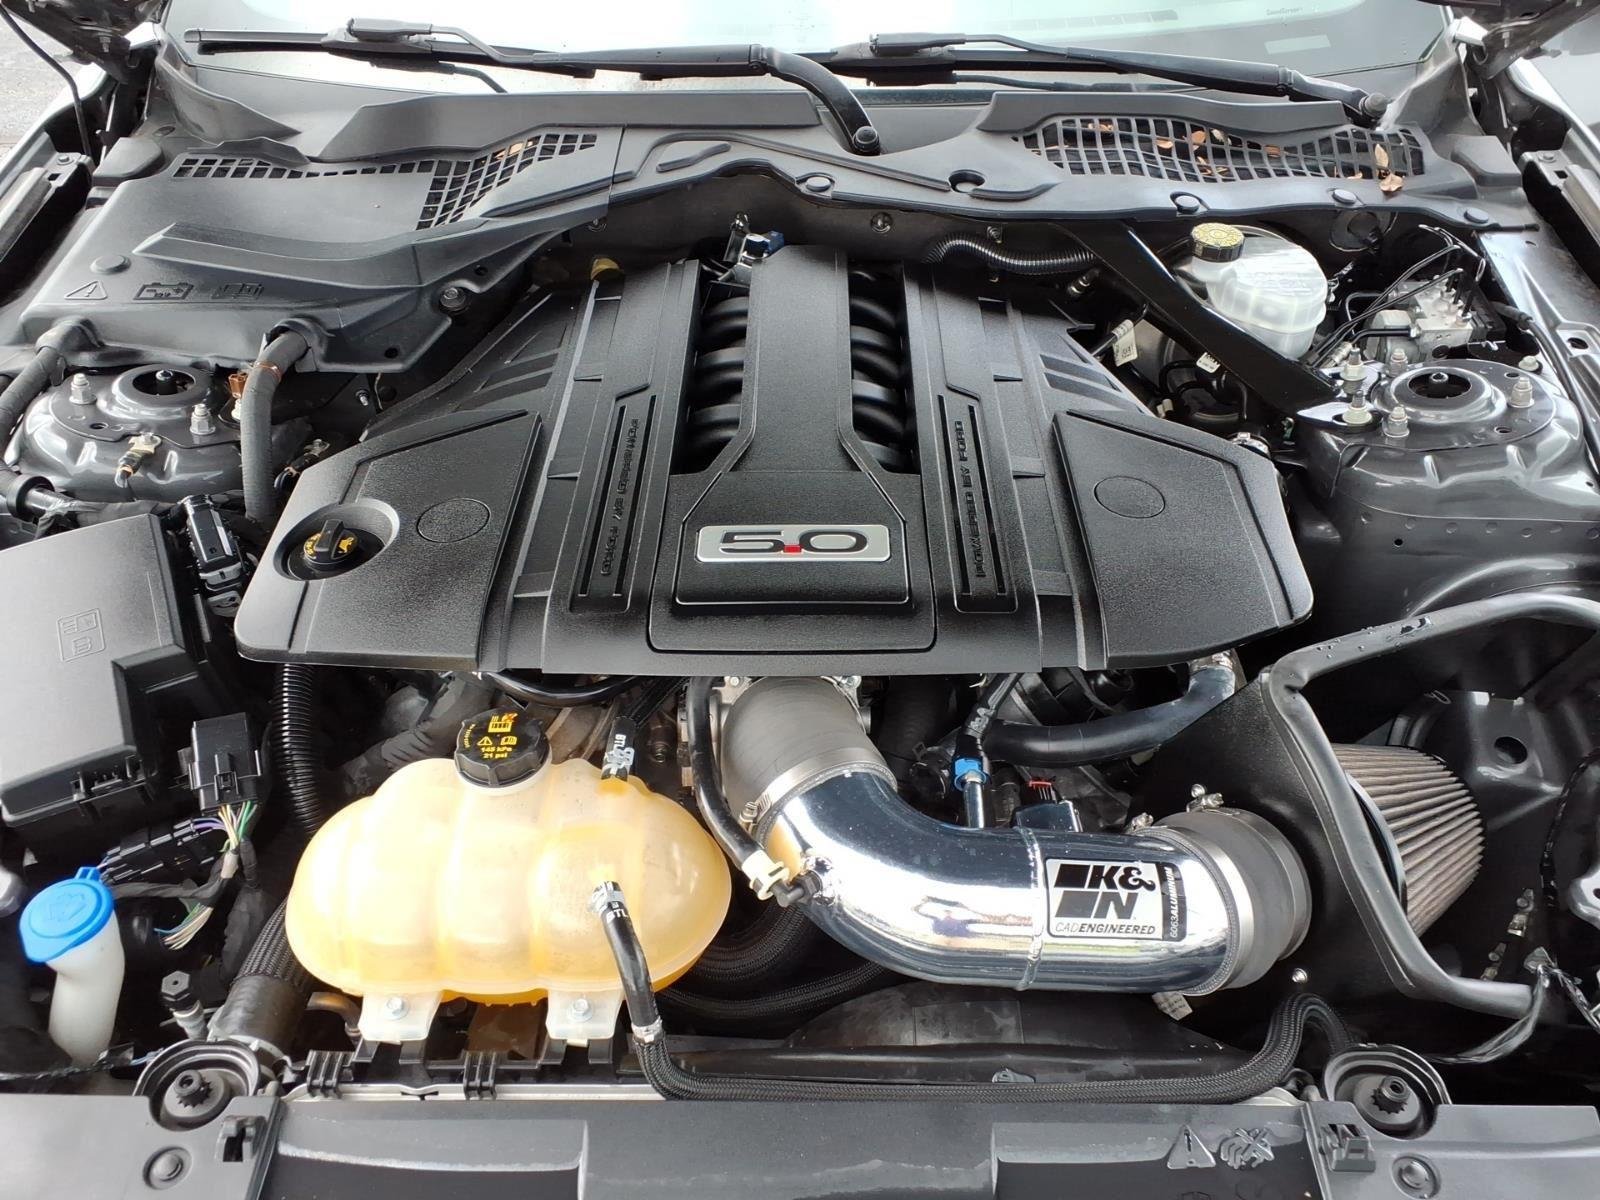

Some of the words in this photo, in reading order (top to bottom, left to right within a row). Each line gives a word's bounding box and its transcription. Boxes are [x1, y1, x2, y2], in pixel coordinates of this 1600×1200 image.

[954, 420, 969, 461] FORD
[617, 418, 639, 494] POWERED
[959, 465, 973, 487] BY
[612, 497, 625, 521] BY
[719, 530, 869, 554] 5.0
[965, 491, 986, 577] POWERED
[601, 526, 618, 575] FORD
[1087, 864, 1156, 892] K&
[1093, 890, 1139, 920] N
